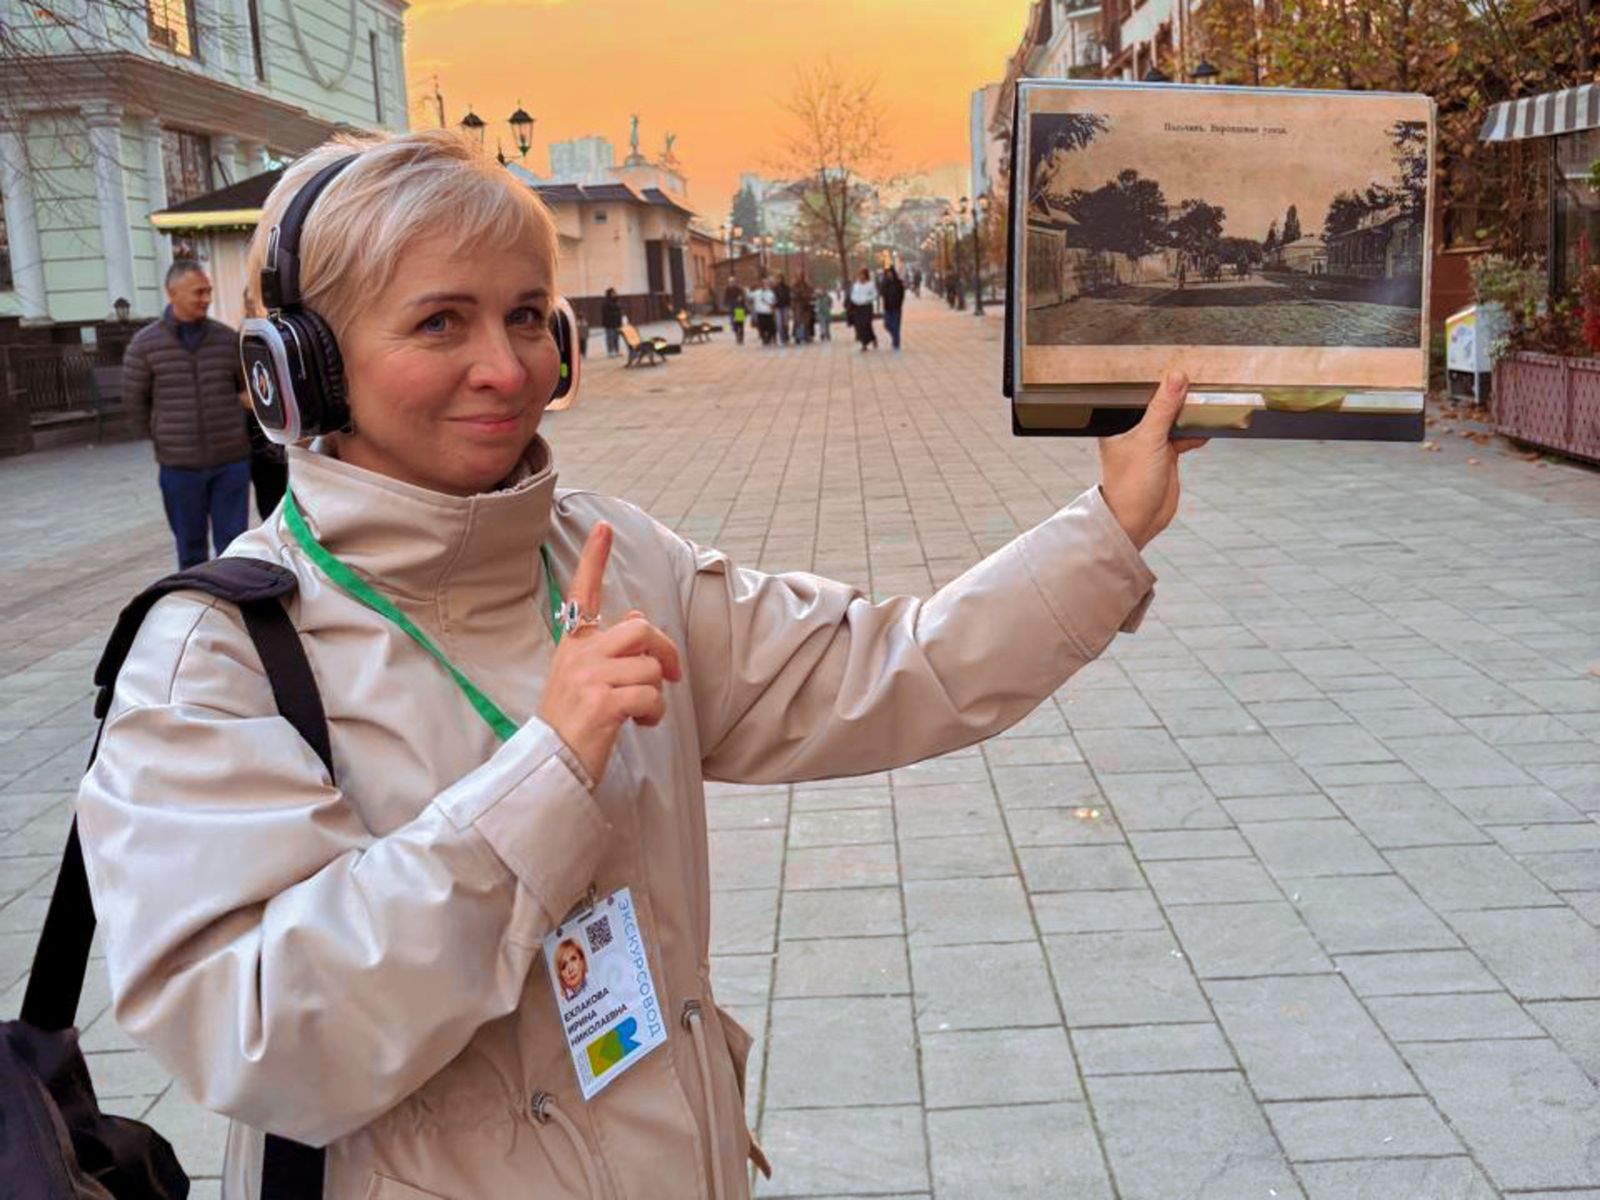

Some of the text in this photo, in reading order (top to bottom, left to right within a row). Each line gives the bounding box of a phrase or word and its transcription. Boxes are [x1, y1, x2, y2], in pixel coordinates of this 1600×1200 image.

[618, 898, 661, 1037] ЭКСКУРСОВОД
[564, 987, 609, 1022] ЕХЛАКОВА
[567, 1010, 597, 1035] ИРИНА
[571, 1003, 628, 1046] НИКОЛАЕВНА
